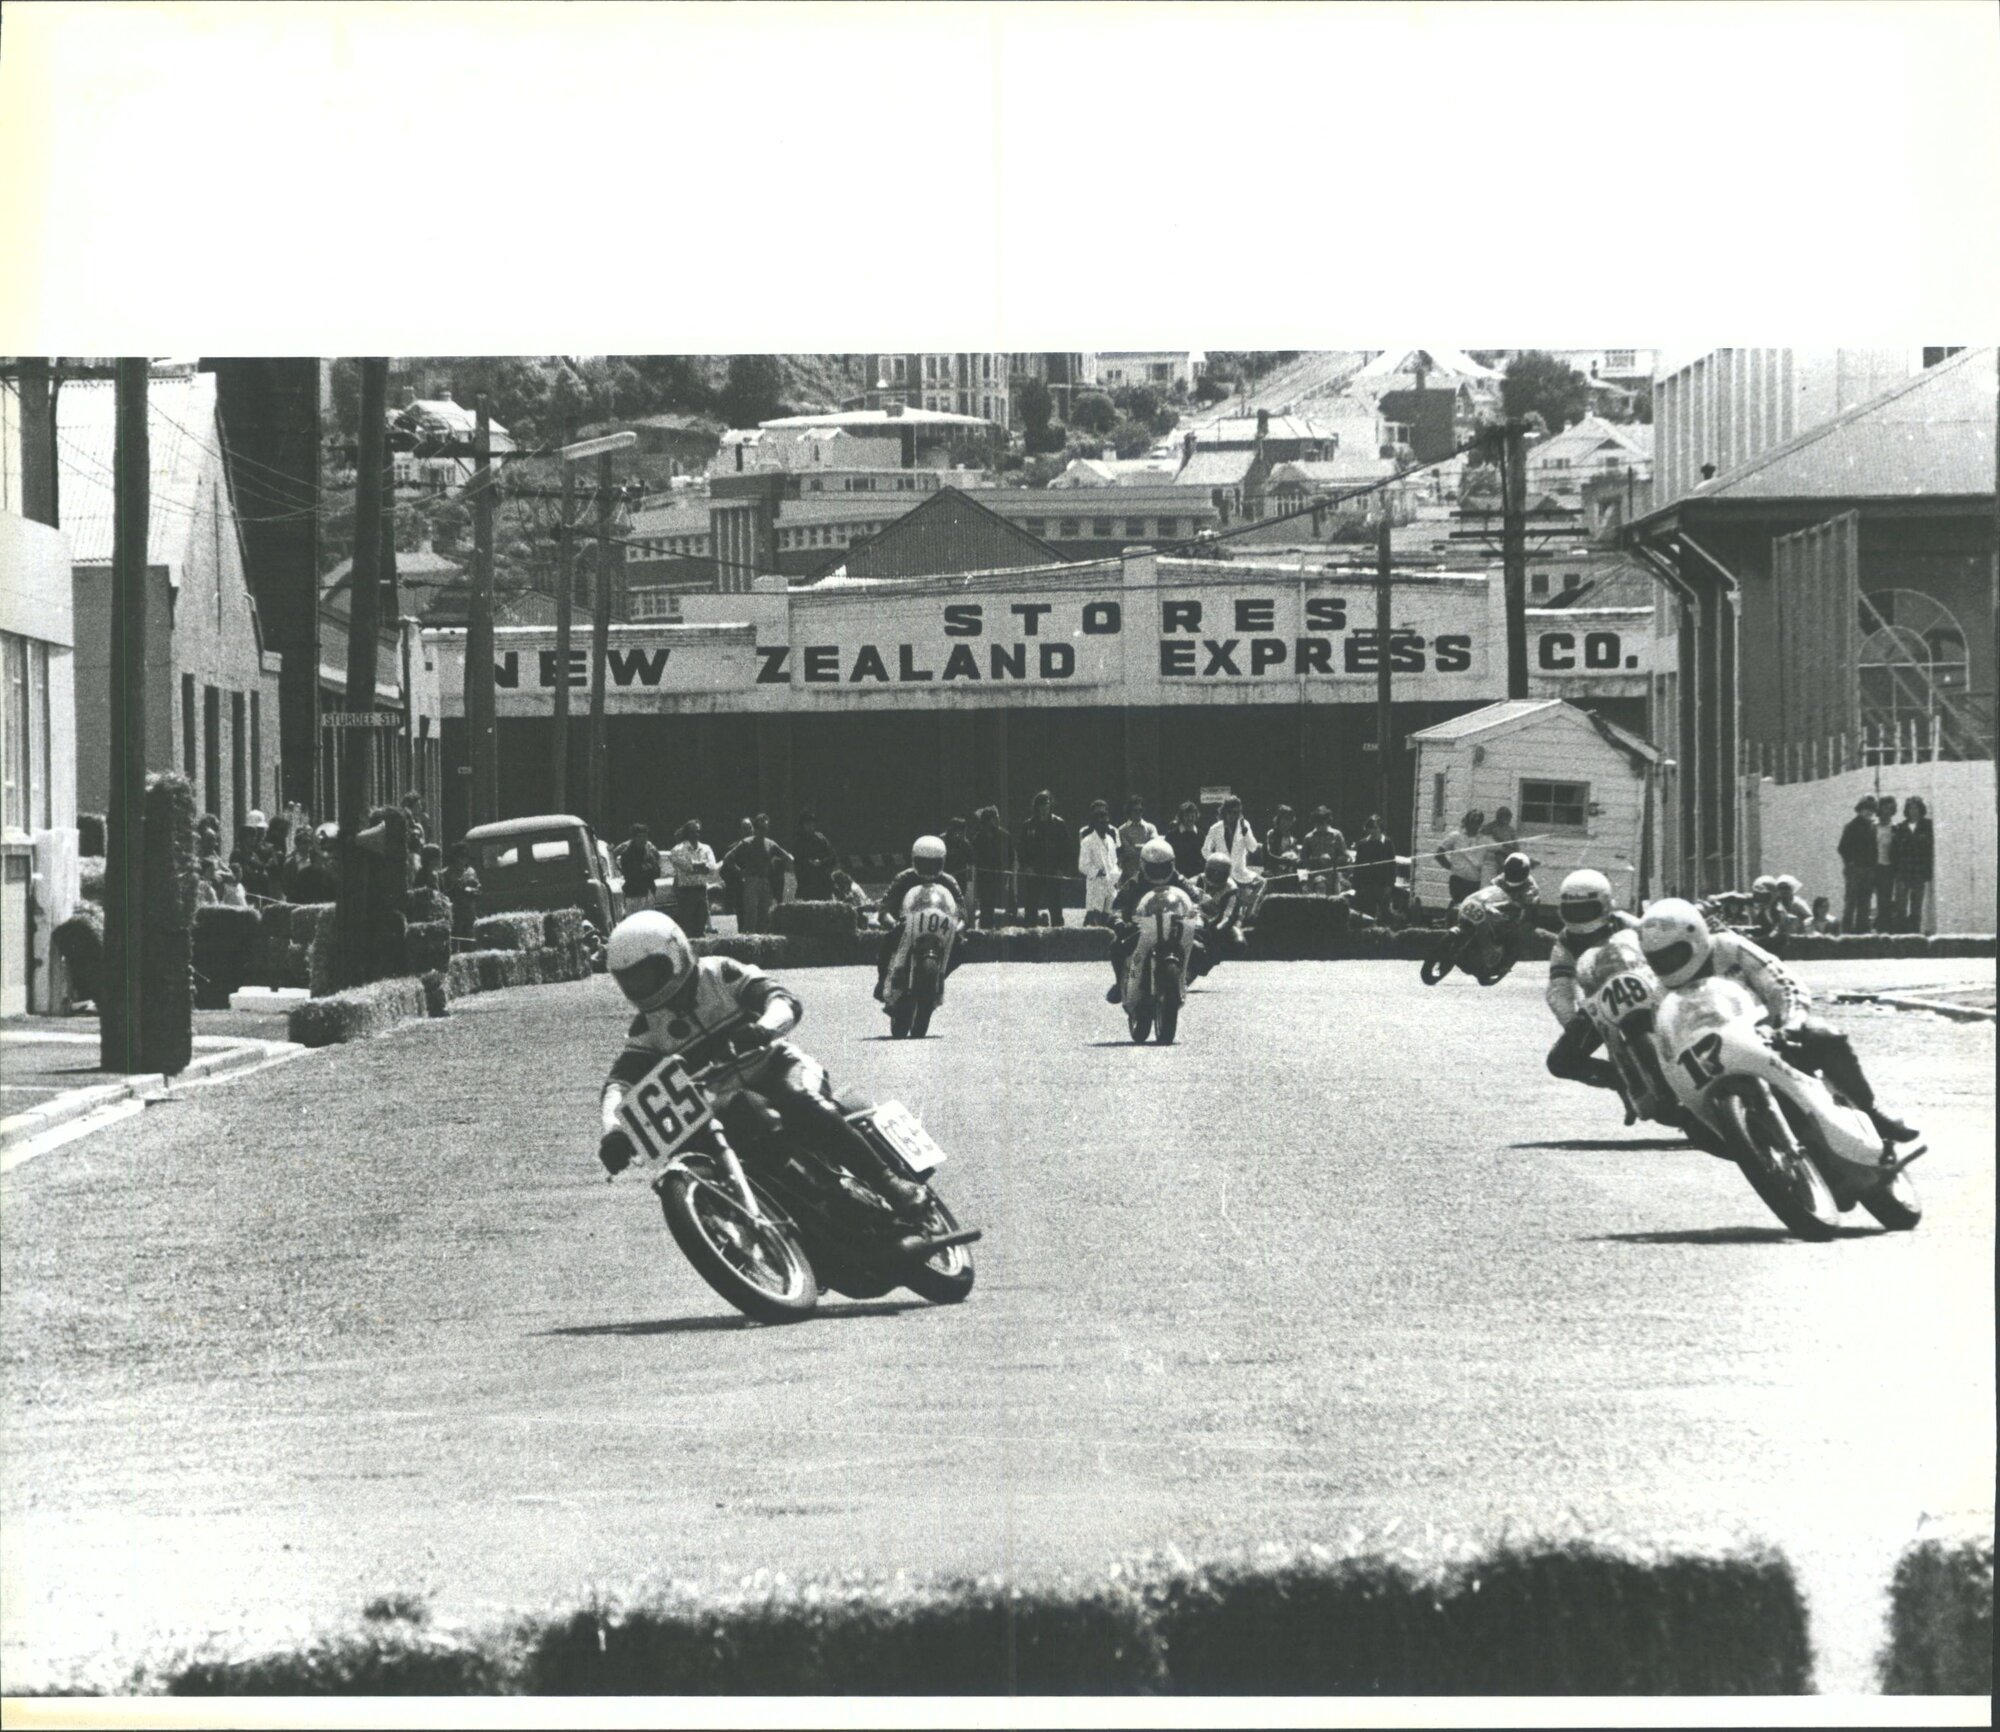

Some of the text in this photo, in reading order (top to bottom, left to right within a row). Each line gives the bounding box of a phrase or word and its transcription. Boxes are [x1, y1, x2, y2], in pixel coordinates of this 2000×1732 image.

[944, 600, 1347, 637] STORES
[756, 643, 1075, 684] ZEALAND
[1160, 634, 1472, 676] EXPRESS
[1538, 632, 1639, 671] CO.
[325, 713, 374, 726] STURDEE
[919, 912, 950, 936] 104
[621, 1061, 706, 1160] 165
